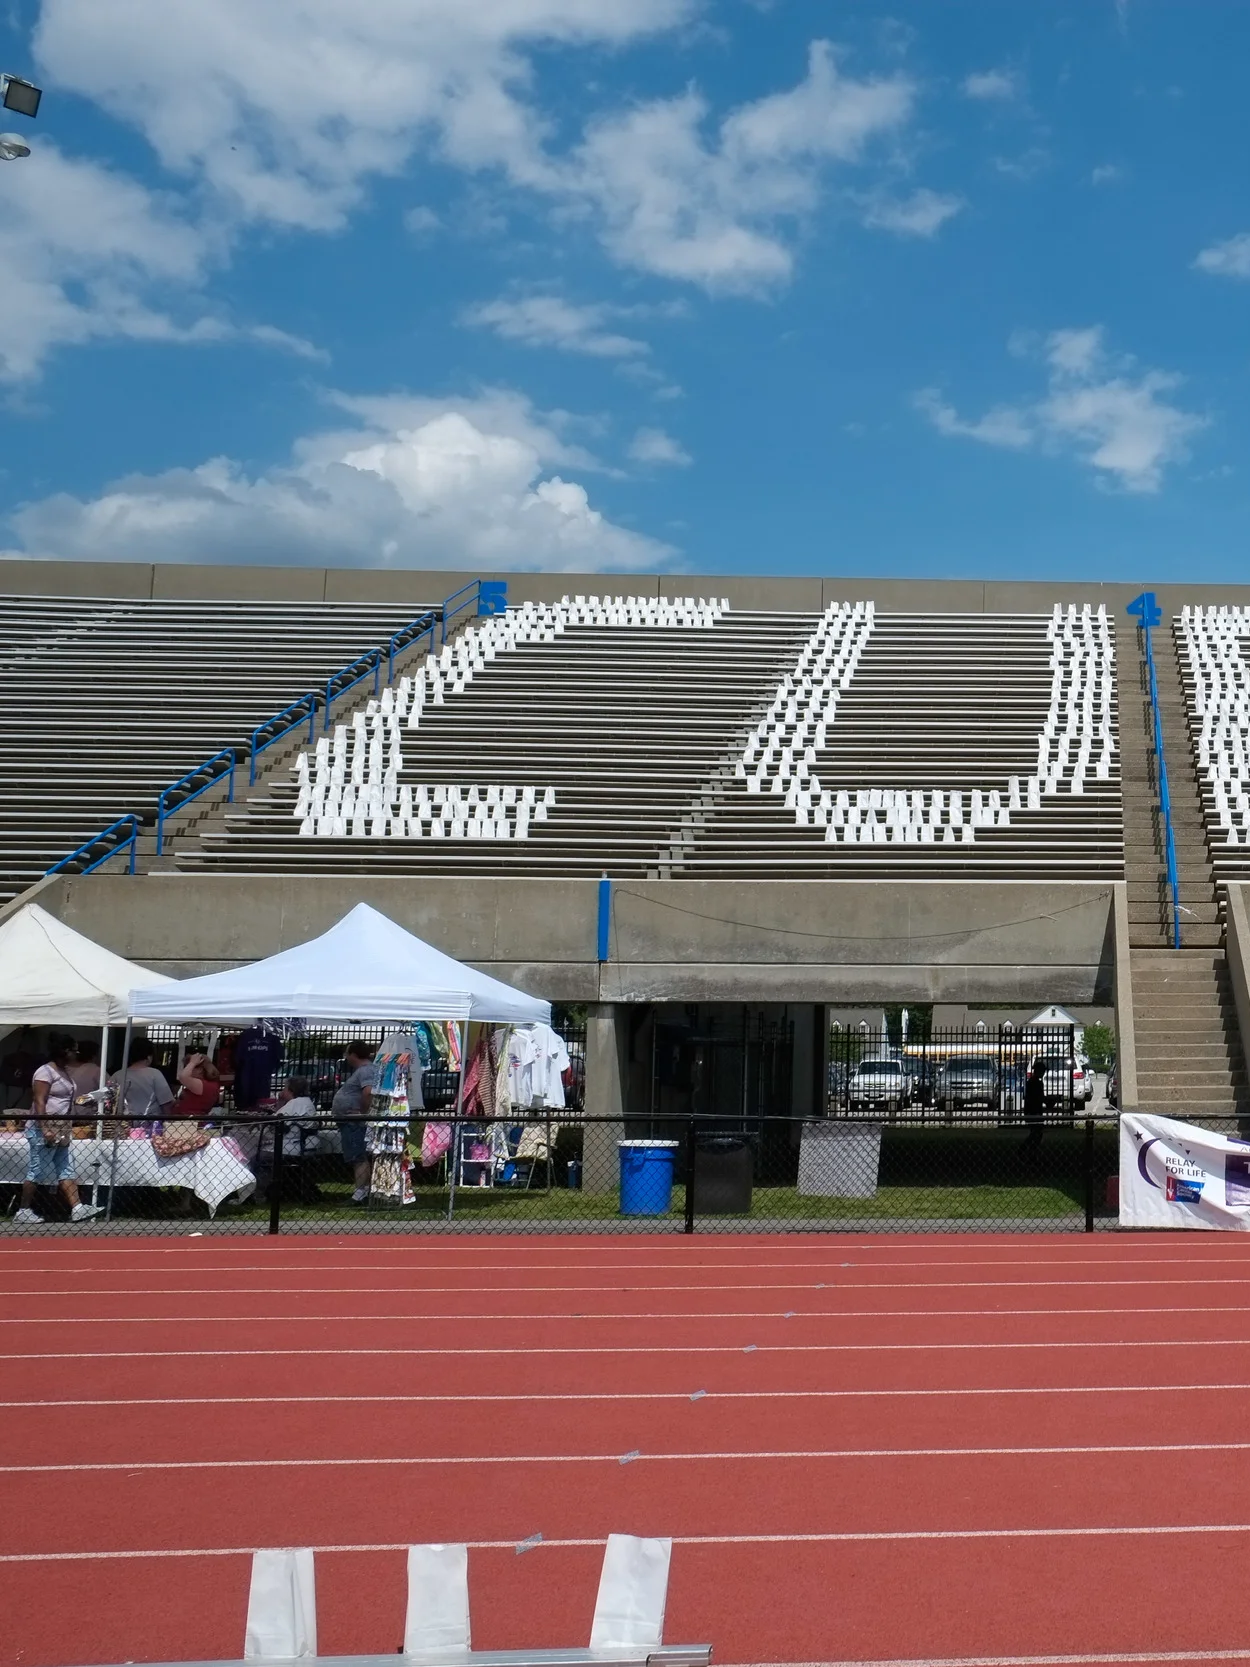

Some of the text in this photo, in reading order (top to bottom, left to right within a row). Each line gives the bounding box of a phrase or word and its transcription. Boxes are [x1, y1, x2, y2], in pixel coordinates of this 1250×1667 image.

[479, 581, 508, 615] 5
[1126, 592, 1162, 627] 4
[1165, 1156, 1195, 1167] RELAY
[1165, 1166, 1206, 1178] FOR LIFE
